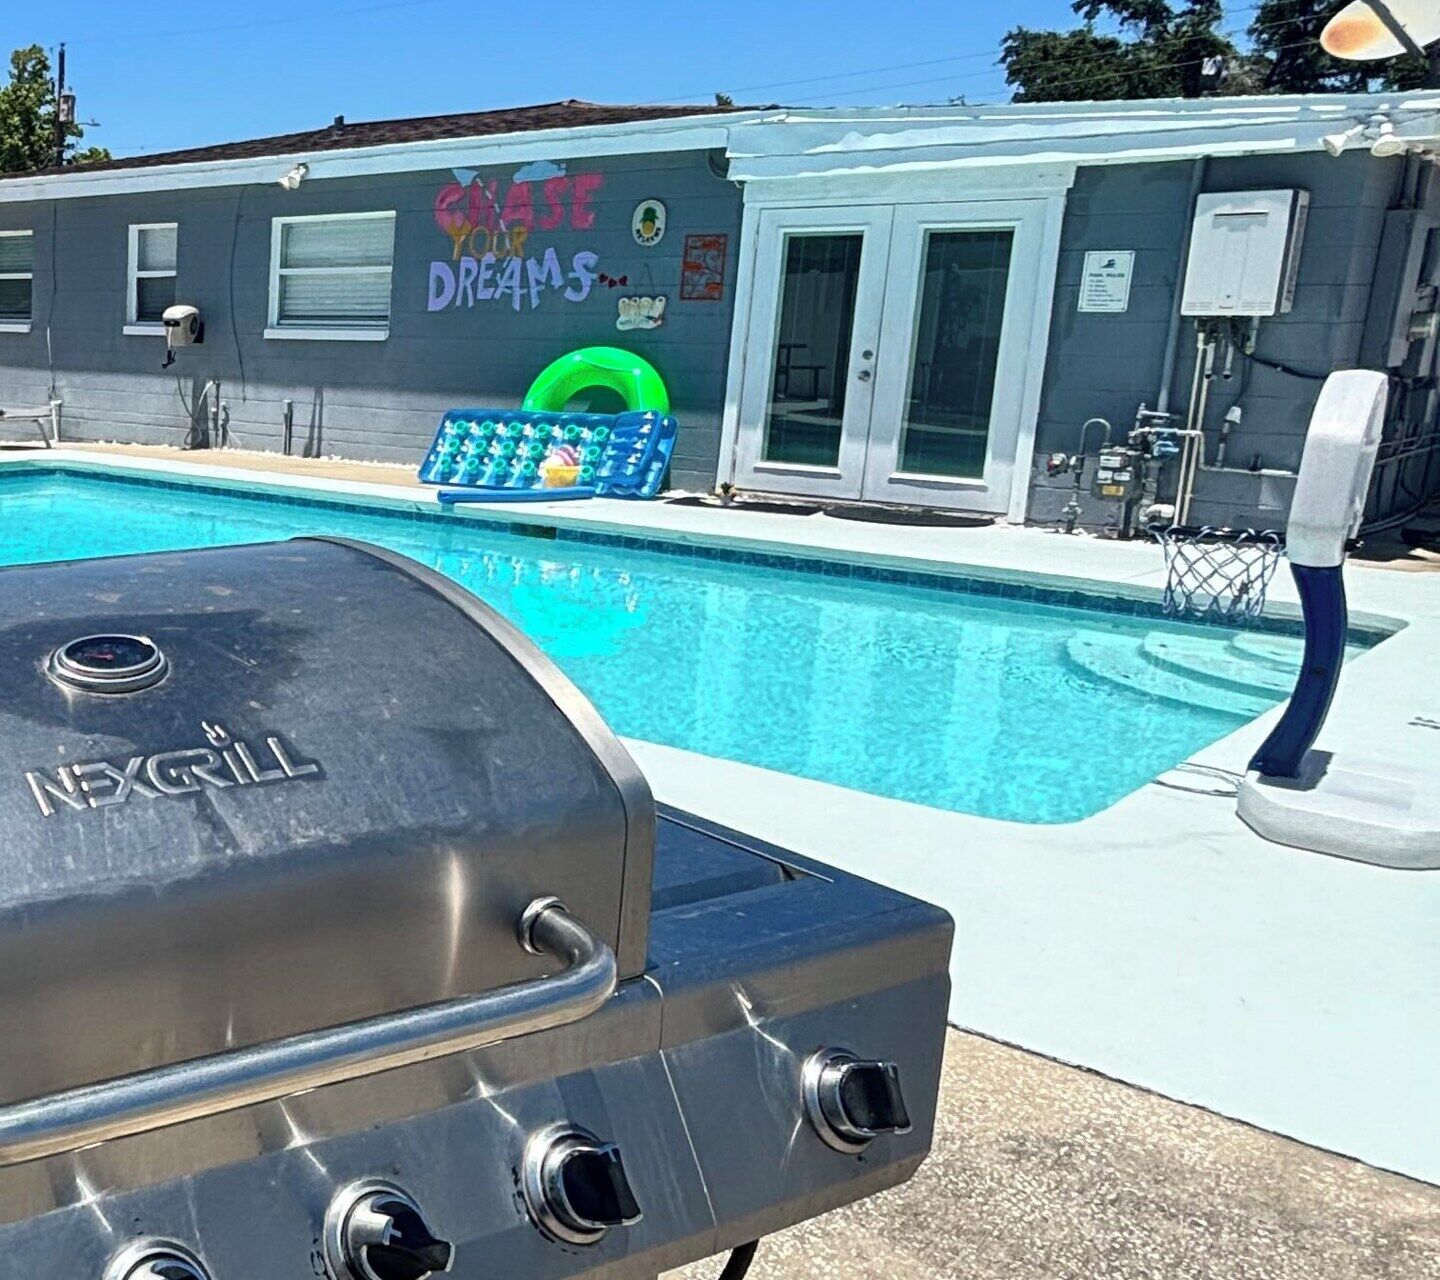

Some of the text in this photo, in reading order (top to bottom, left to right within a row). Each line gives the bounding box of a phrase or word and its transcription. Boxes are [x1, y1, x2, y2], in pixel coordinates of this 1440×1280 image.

[435, 174, 604, 235] CHASE
[448, 219, 528, 261] YOUR
[427, 247, 600, 312] DREAMS
